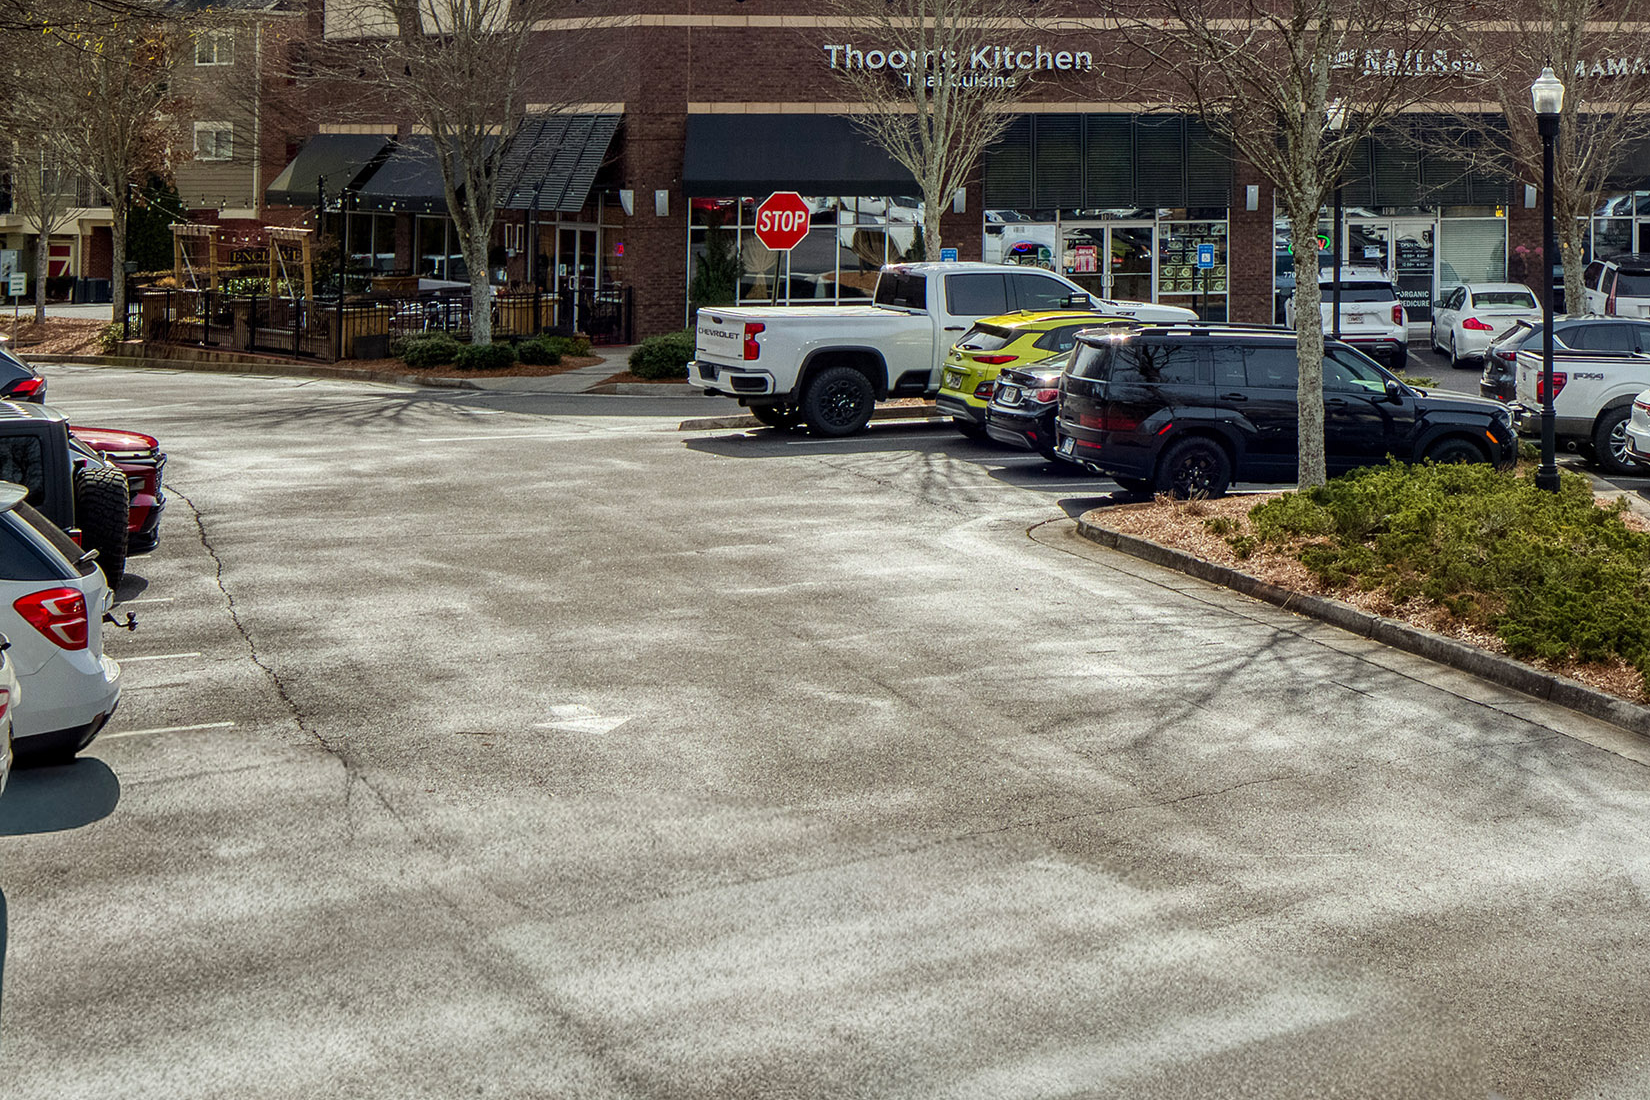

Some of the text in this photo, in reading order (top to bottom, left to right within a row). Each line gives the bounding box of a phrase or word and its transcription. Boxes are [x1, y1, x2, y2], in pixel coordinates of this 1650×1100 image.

[823, 44, 1093, 70] Thoom's Kitchen
[903, 73, 943, 88] Tai
[760, 210, 806, 232] STOP
[232, 250, 302, 261] ENCLVE
[1399, 290, 1430, 298] ORGANIC
[698, 327, 741, 340] CHEVROLET
